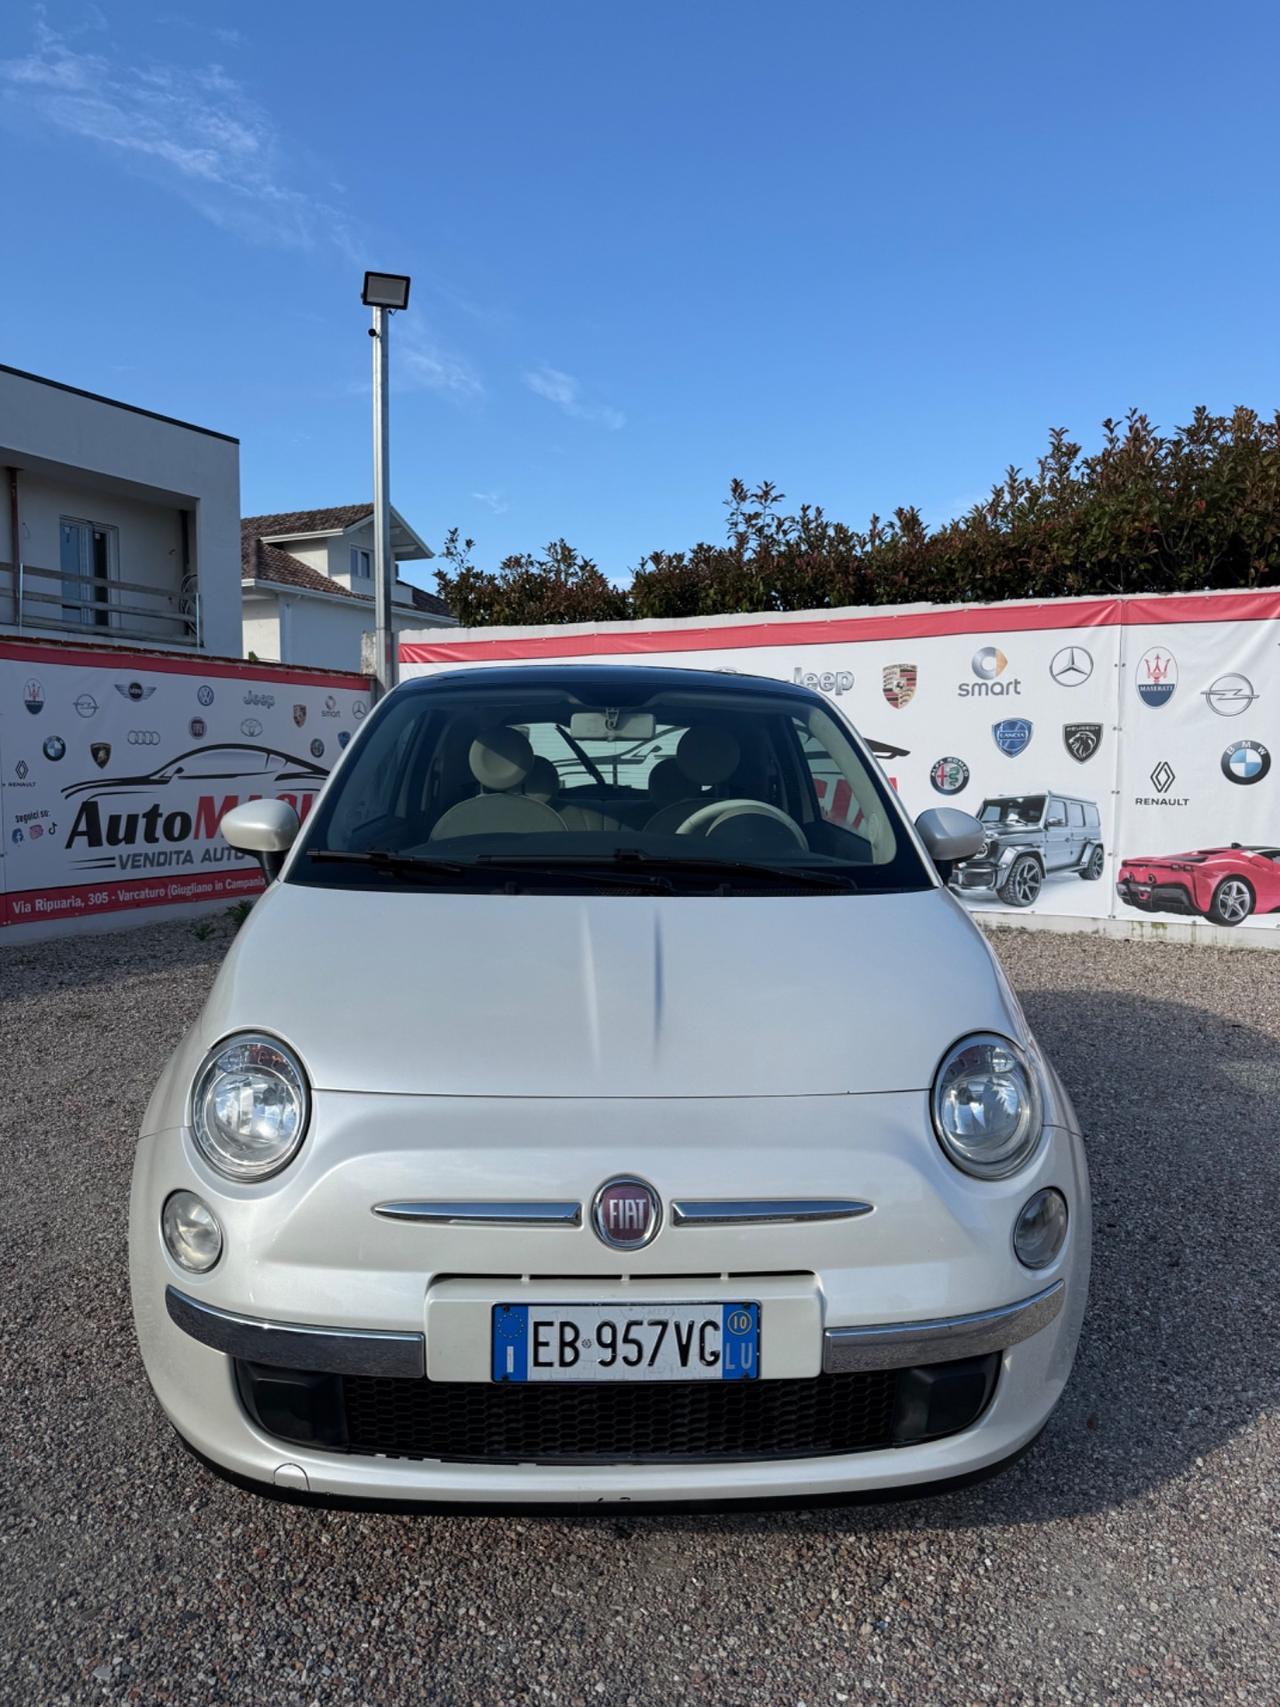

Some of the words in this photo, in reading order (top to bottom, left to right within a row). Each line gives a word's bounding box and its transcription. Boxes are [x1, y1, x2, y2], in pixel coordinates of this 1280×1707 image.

[958, 678, 1021, 697] smart
[242, 690, 275, 709] Jeep
[321, 709, 341, 718] smart
[1135, 797, 1190, 806] RENAULT
[118, 850, 194, 870] VENDITA
[12, 901, 32, 914] Via
[35, 896, 85, 912] Ripuaria,
[88, 892, 109, 905] 305
[117, 888, 166, 902] Varcaturo
[215, 880, 224, 890] in
[608, 1198, 648, 1230] FIAT
[732, 1314, 748, 1330] 10
[725, 1342, 753, 1371] LU
